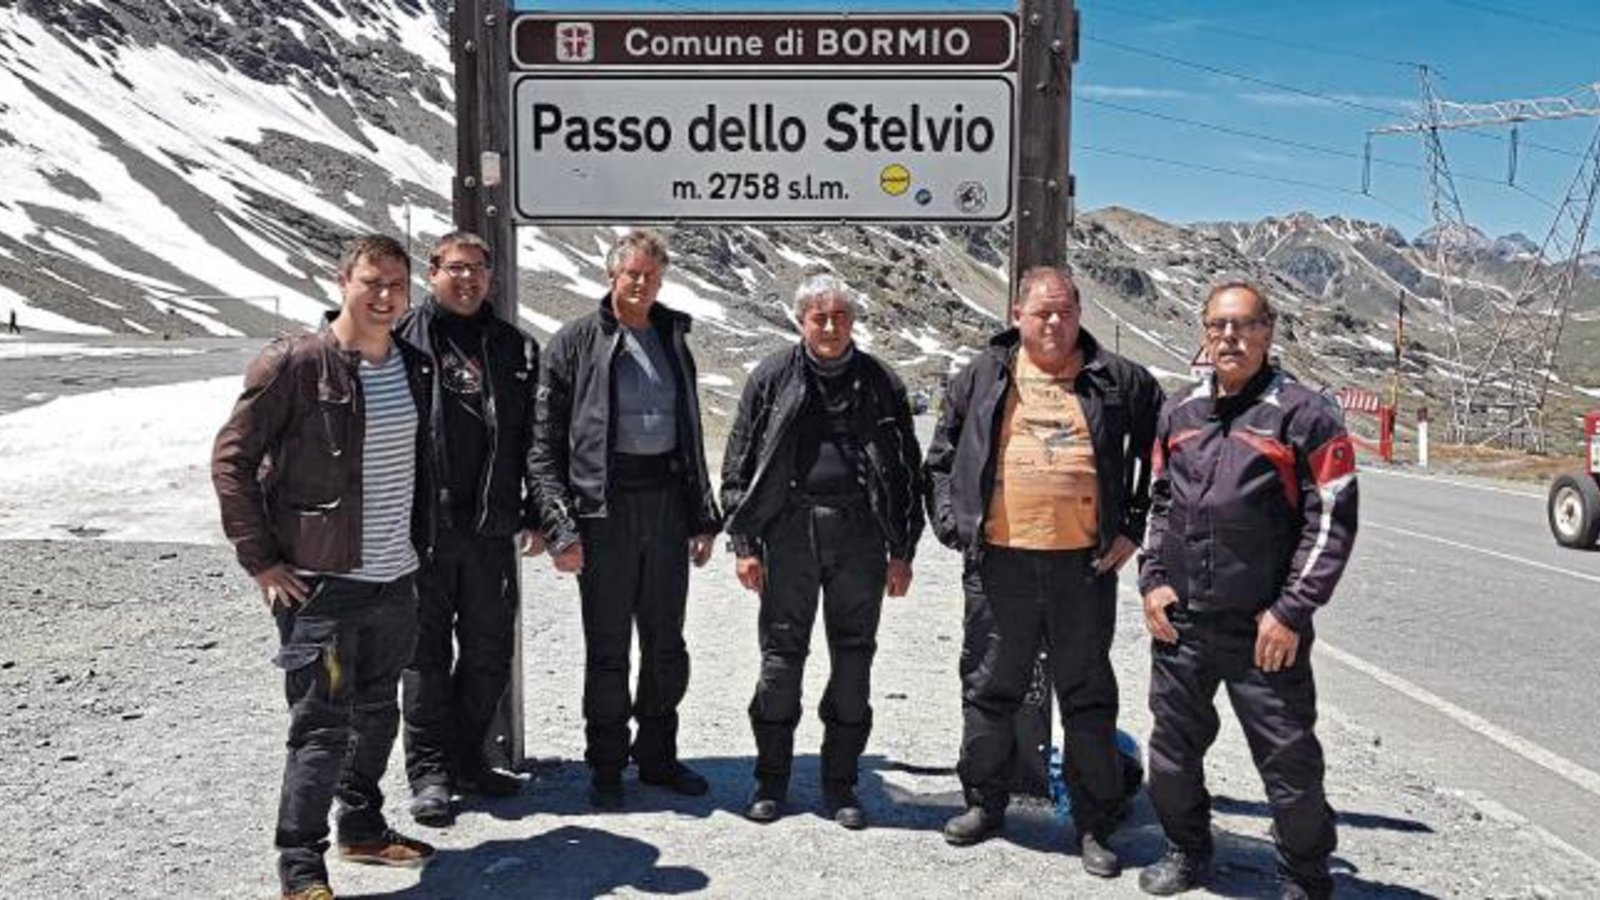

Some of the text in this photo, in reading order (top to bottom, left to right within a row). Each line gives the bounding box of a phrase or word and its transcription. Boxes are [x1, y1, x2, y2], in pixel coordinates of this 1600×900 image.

[624, 28, 971, 56] Comune di BORMIO
[532, 102, 995, 154] Passo dello Stelvio
[672, 172, 850, 200] m. 2758 s.l.m.
